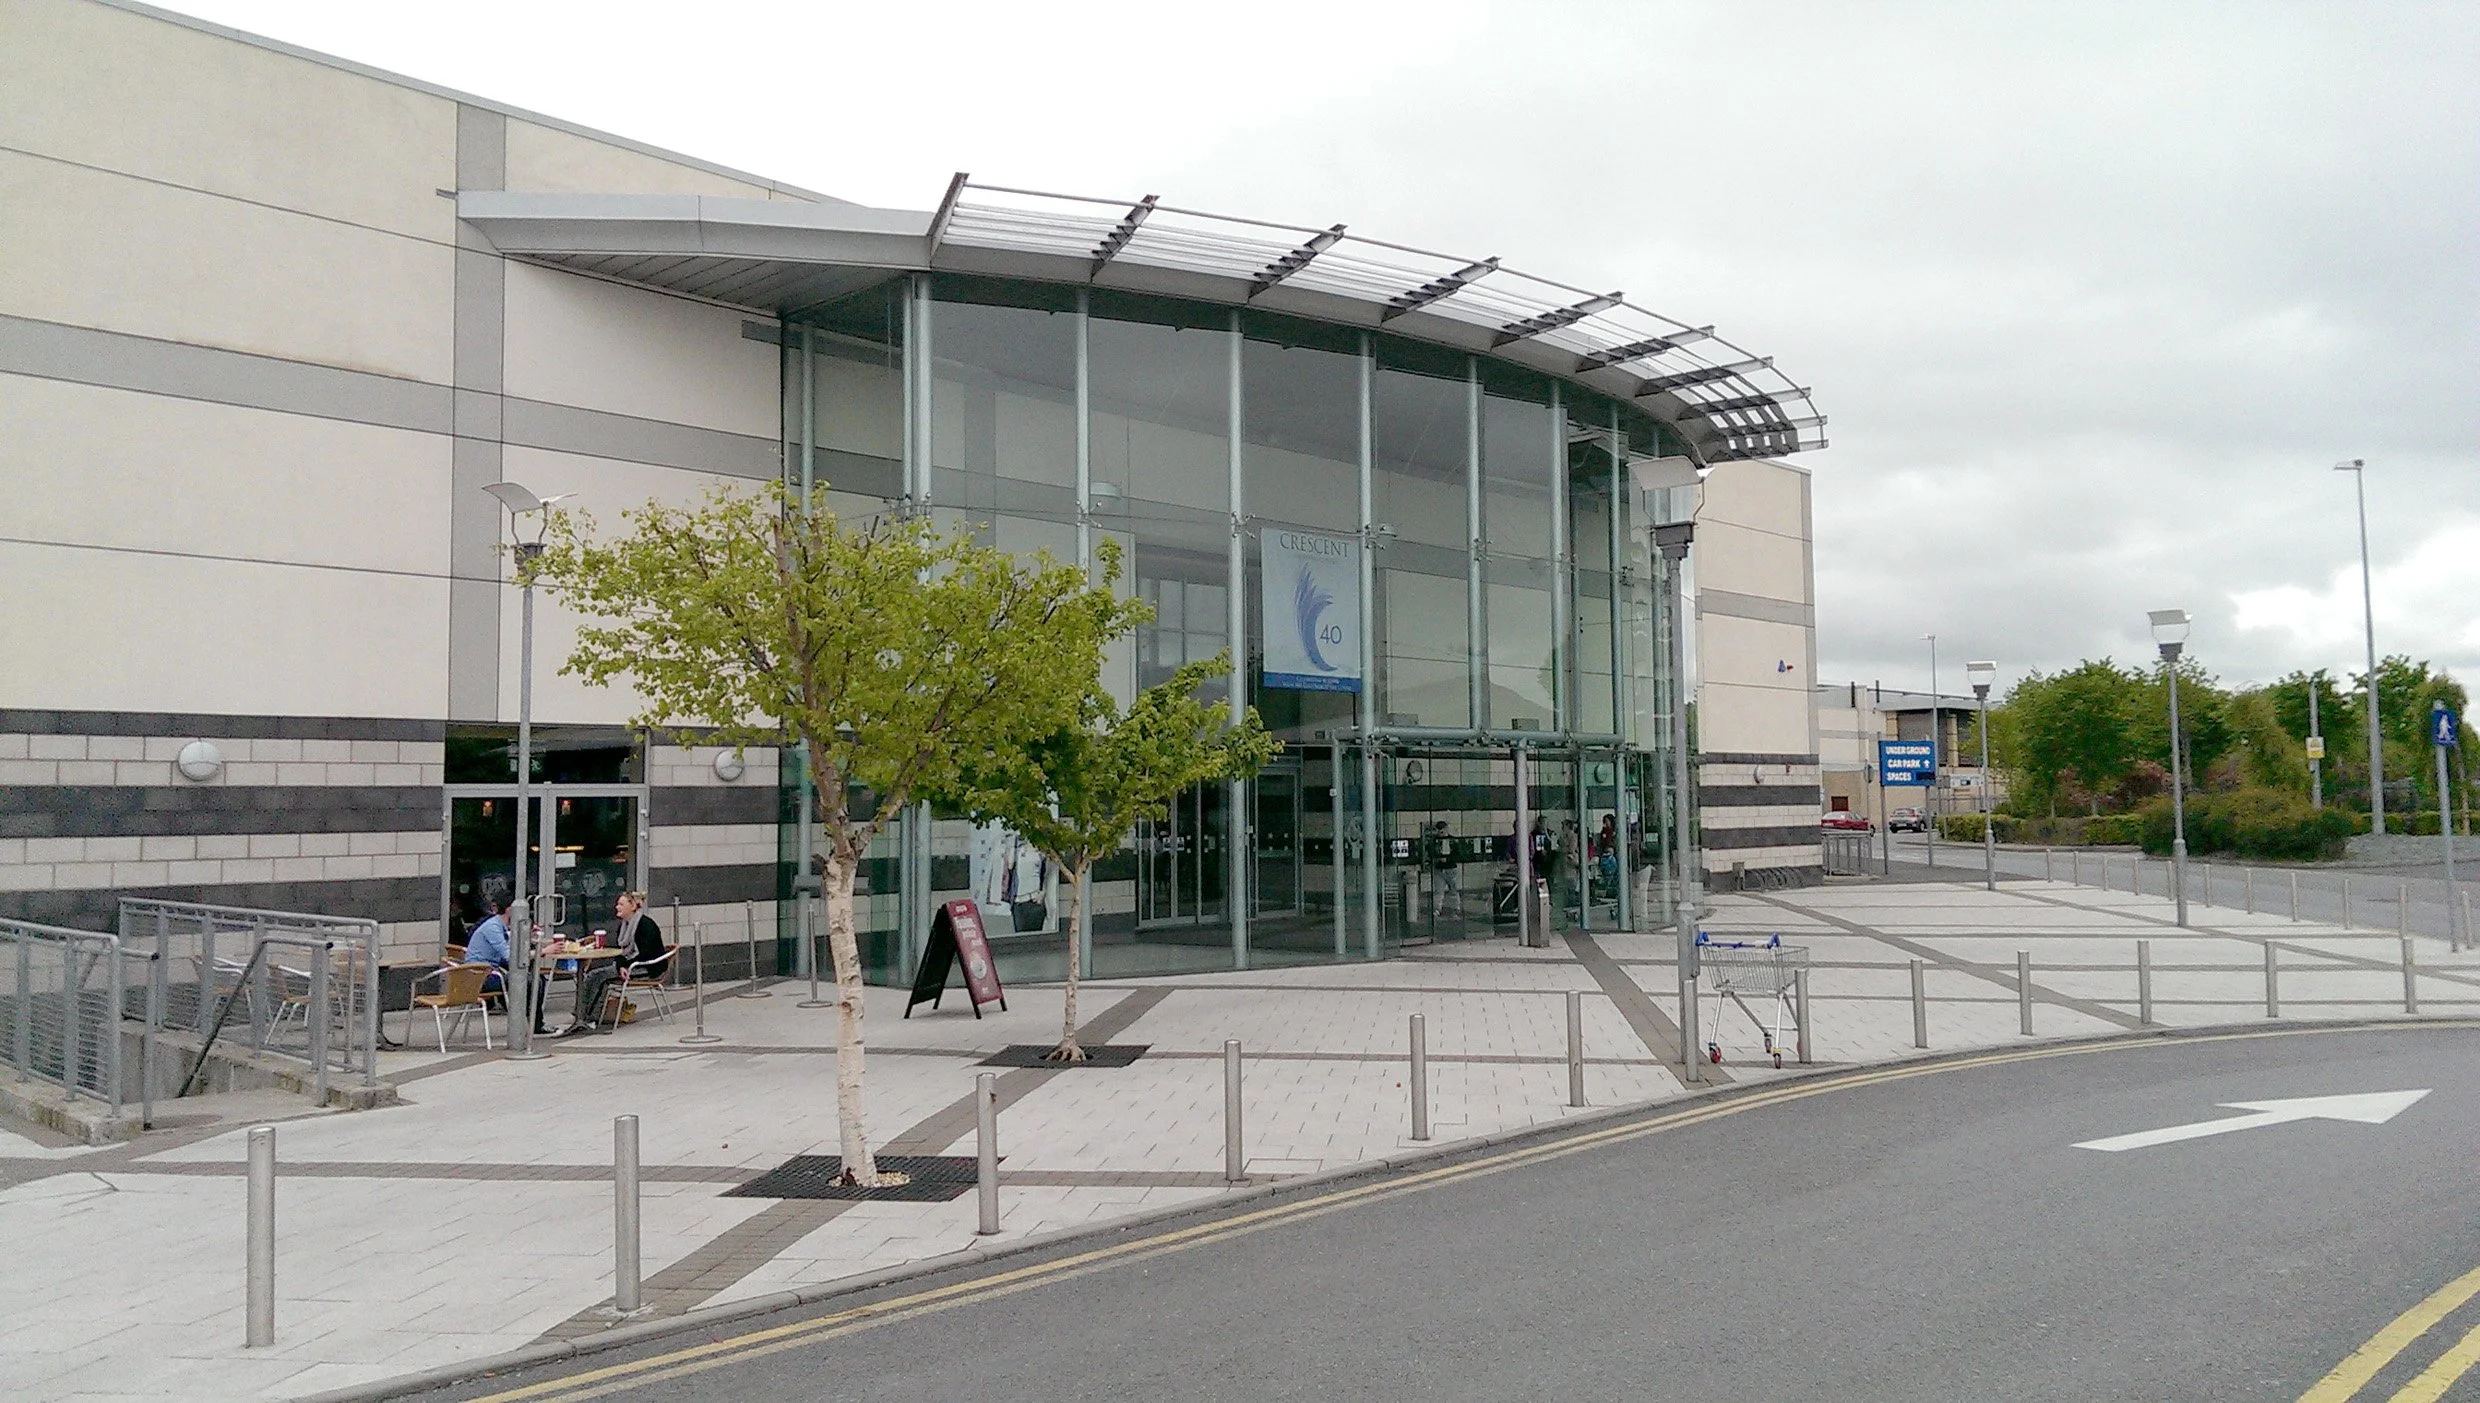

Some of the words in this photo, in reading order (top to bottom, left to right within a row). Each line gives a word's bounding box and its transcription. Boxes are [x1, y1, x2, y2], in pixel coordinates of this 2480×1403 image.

[1280, 533, 1348, 557] CRESCENT
[1320, 624, 1342, 645] 40
[1888, 759, 1902, 768] CAR
[1903, 759, 1921, 768] PARK
[1887, 772, 1912, 781] SPACES
